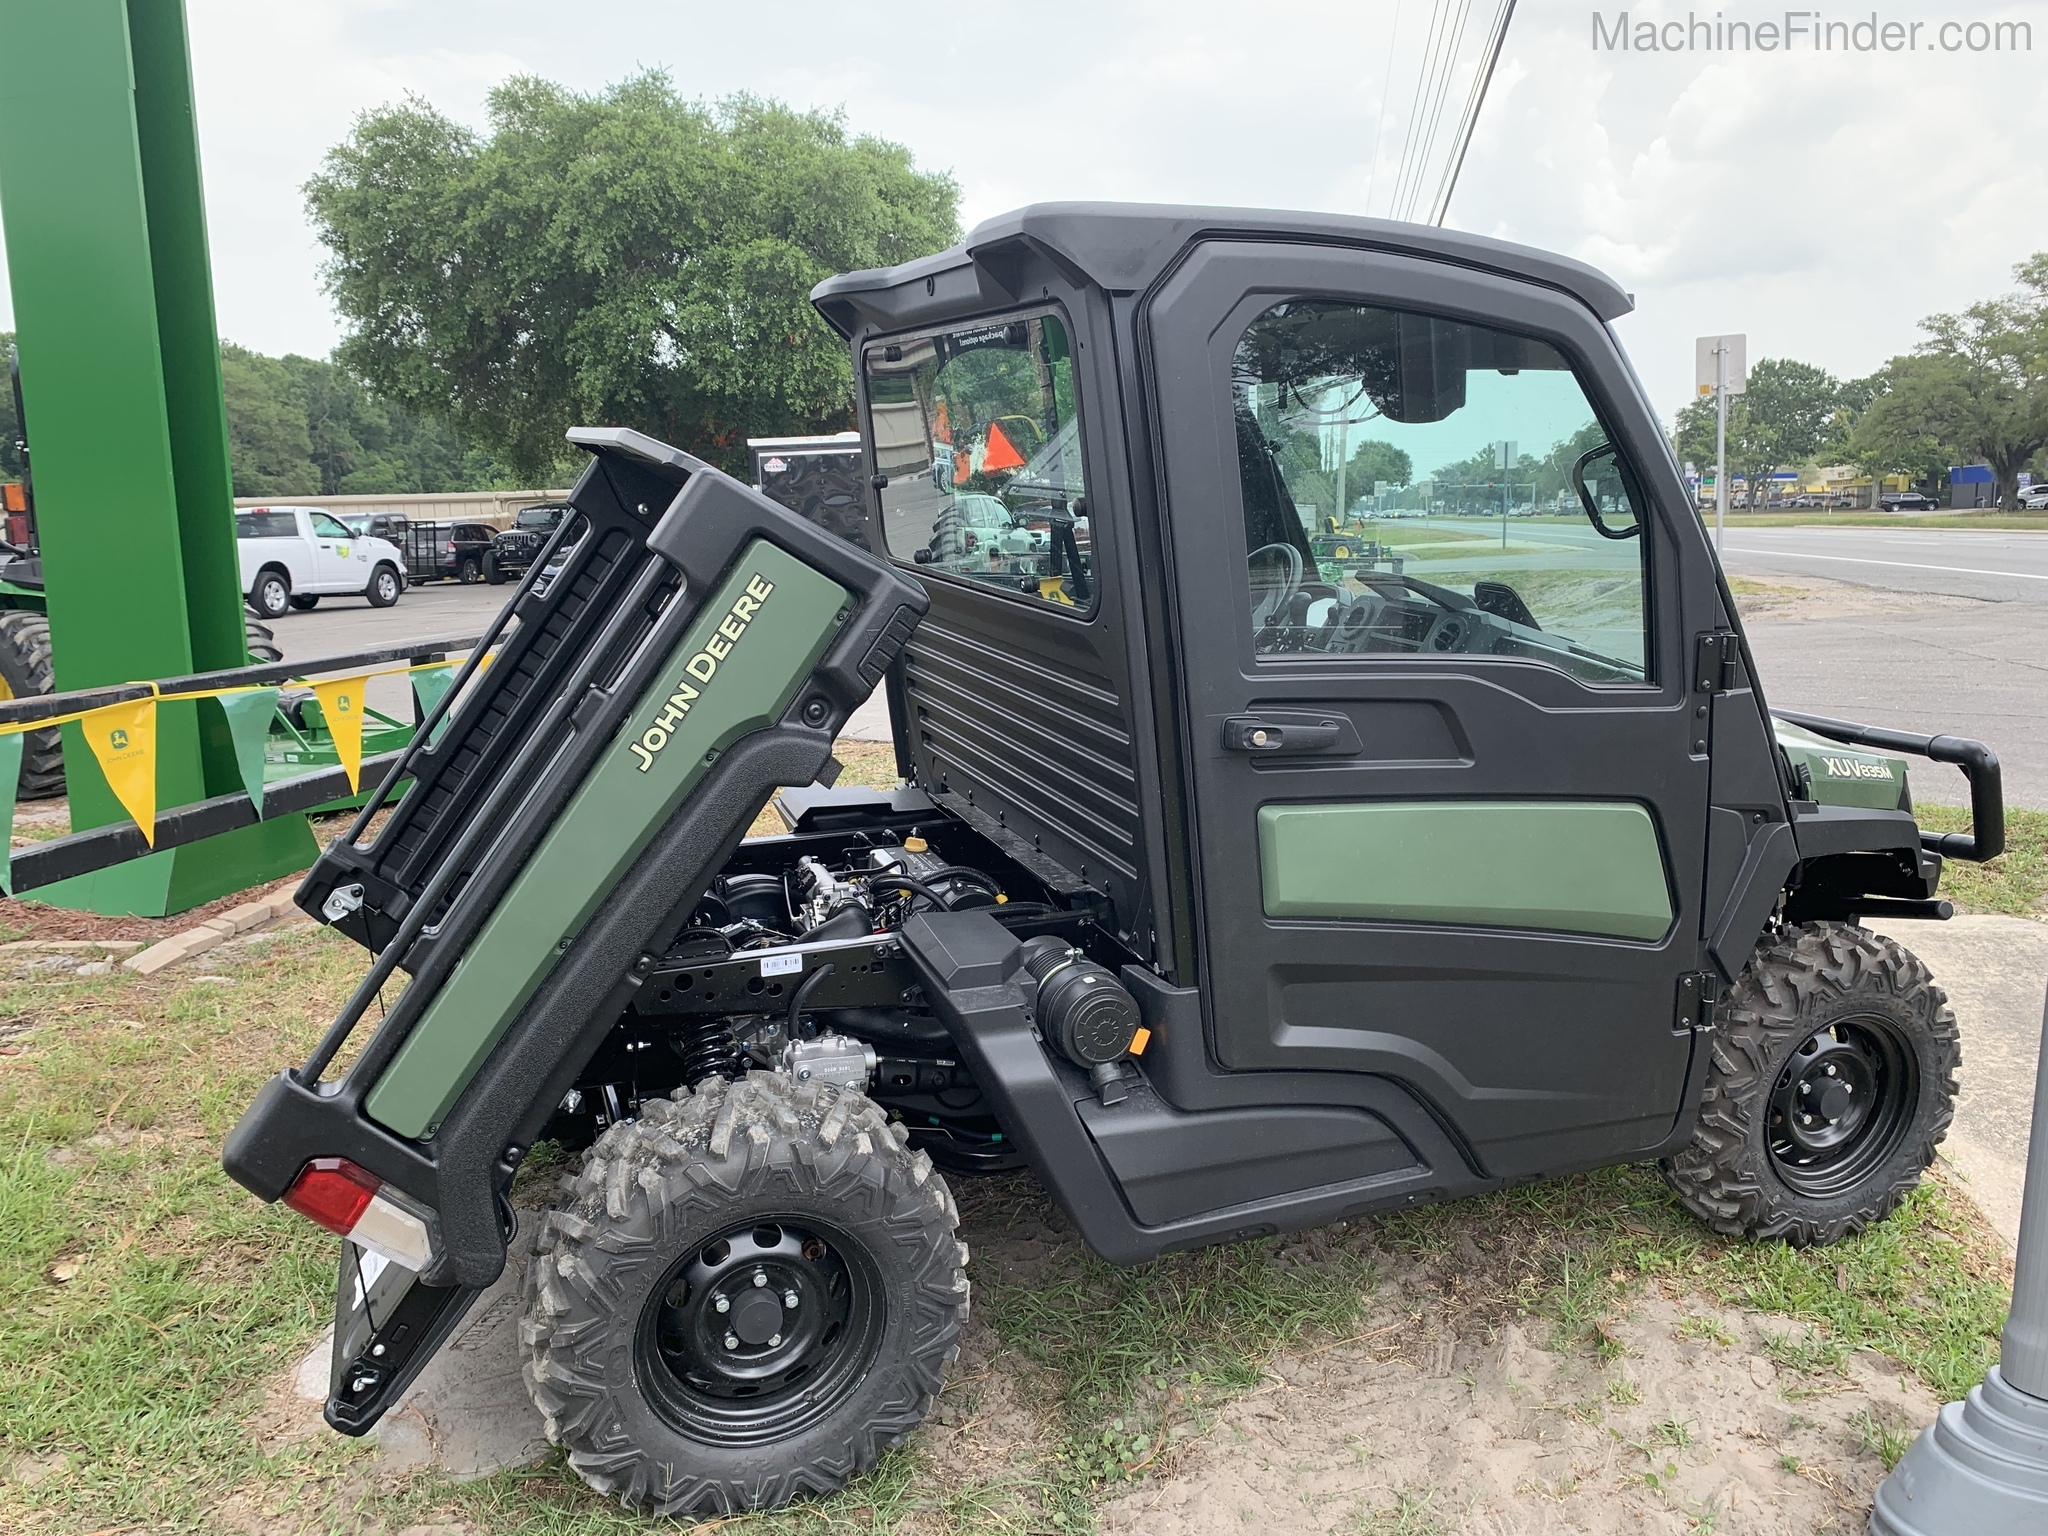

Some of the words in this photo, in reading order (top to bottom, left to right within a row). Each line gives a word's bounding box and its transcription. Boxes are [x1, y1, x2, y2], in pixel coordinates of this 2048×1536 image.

[628, 681, 702, 773] JOHN
[685, 571, 777, 686] DEERE
[1820, 756, 1895, 782] XUV835M
